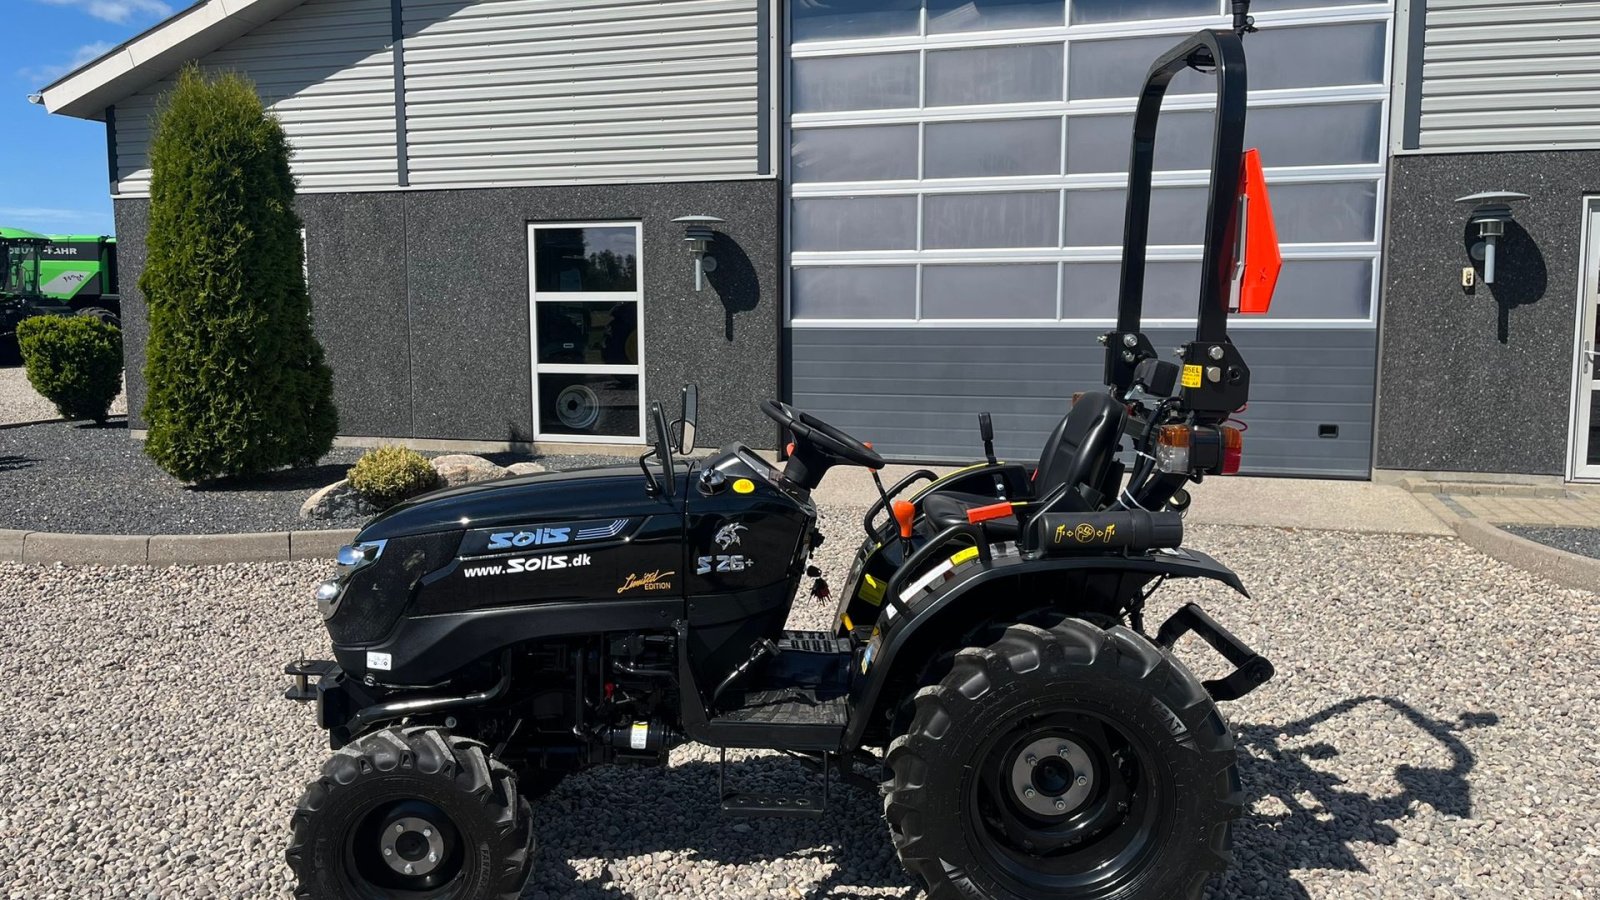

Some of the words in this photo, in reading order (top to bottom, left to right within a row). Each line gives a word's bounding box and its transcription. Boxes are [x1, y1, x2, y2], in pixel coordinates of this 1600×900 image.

[696, 555, 712, 575] S
[617, 569, 676, 594] Limited
[644, 582, 671, 591] EDITION
